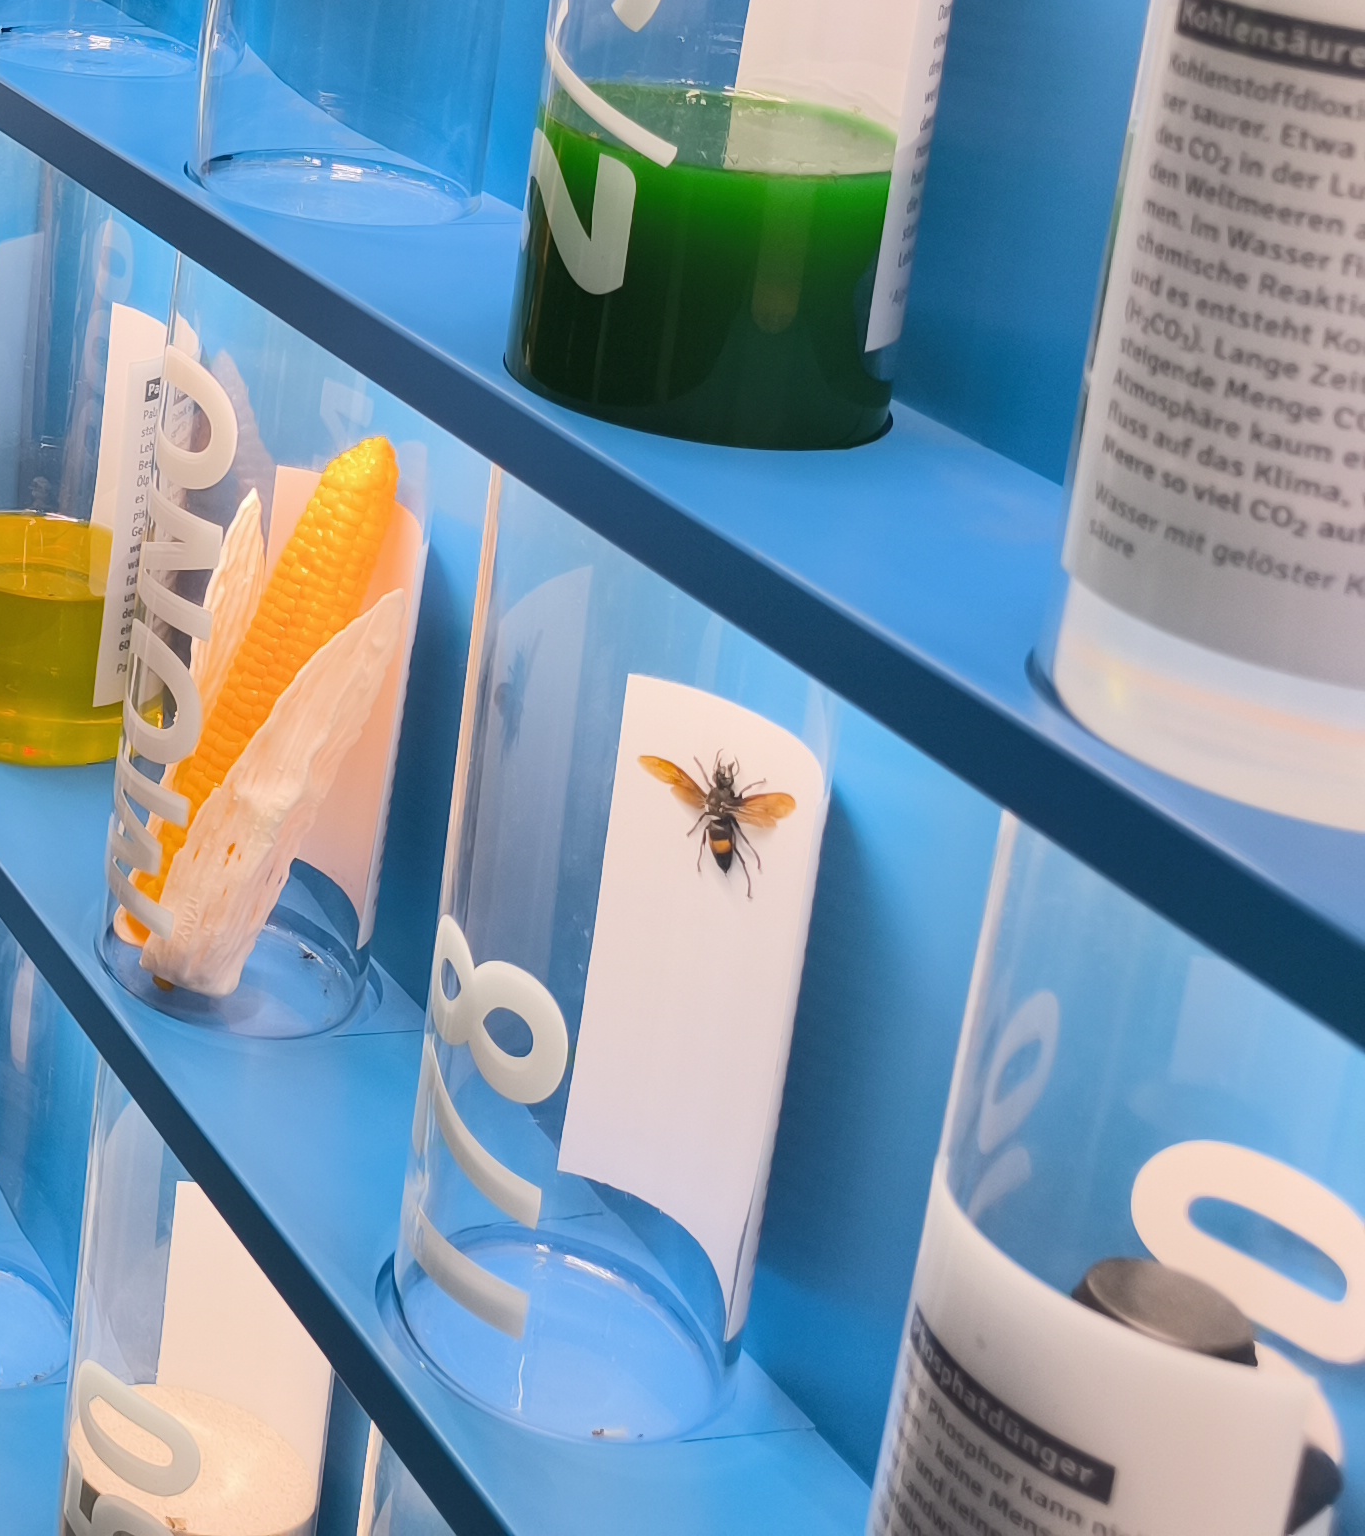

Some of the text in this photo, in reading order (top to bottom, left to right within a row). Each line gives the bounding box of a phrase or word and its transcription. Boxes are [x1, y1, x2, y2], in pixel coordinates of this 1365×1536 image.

[1191, 103, 1270, 144] saurer.
[1279, 122, 1356, 160] Etwa
[1239, 150, 1265, 178] in
[1271, 160, 1320, 191] der
[1184, 172, 1345, 236] Weltmeeren
[1136, 231, 1250, 291] chemische
[1190, 214, 1220, 243] Im
[1226, 224, 1330, 271] Wasser
[1131, 267, 1312, 347] und es entsteht
[1120, 337, 1323, 424] steigende Menge
[1213, 335, 1299, 381] Lange
[1112, 367, 1334, 464] Atmosphäre kaum
[1101, 433, 1155, 481] Meere
[1159, 470, 1188, 495] so
[1192, 482, 1241, 515] viel
[1152, 430, 1194, 459] auf
[1197, 443, 1244, 478] das
[1087, 517, 1136, 560] säure
[1094, 479, 1336, 591] Wasser mit gelöster
[911, 1311, 1096, 1485] Phosphatdünger
[928, 1397, 1015, 1486] Phosphor
[1019, 1476, 1083, 1525] kann
[934, 1440, 984, 1499] keine
